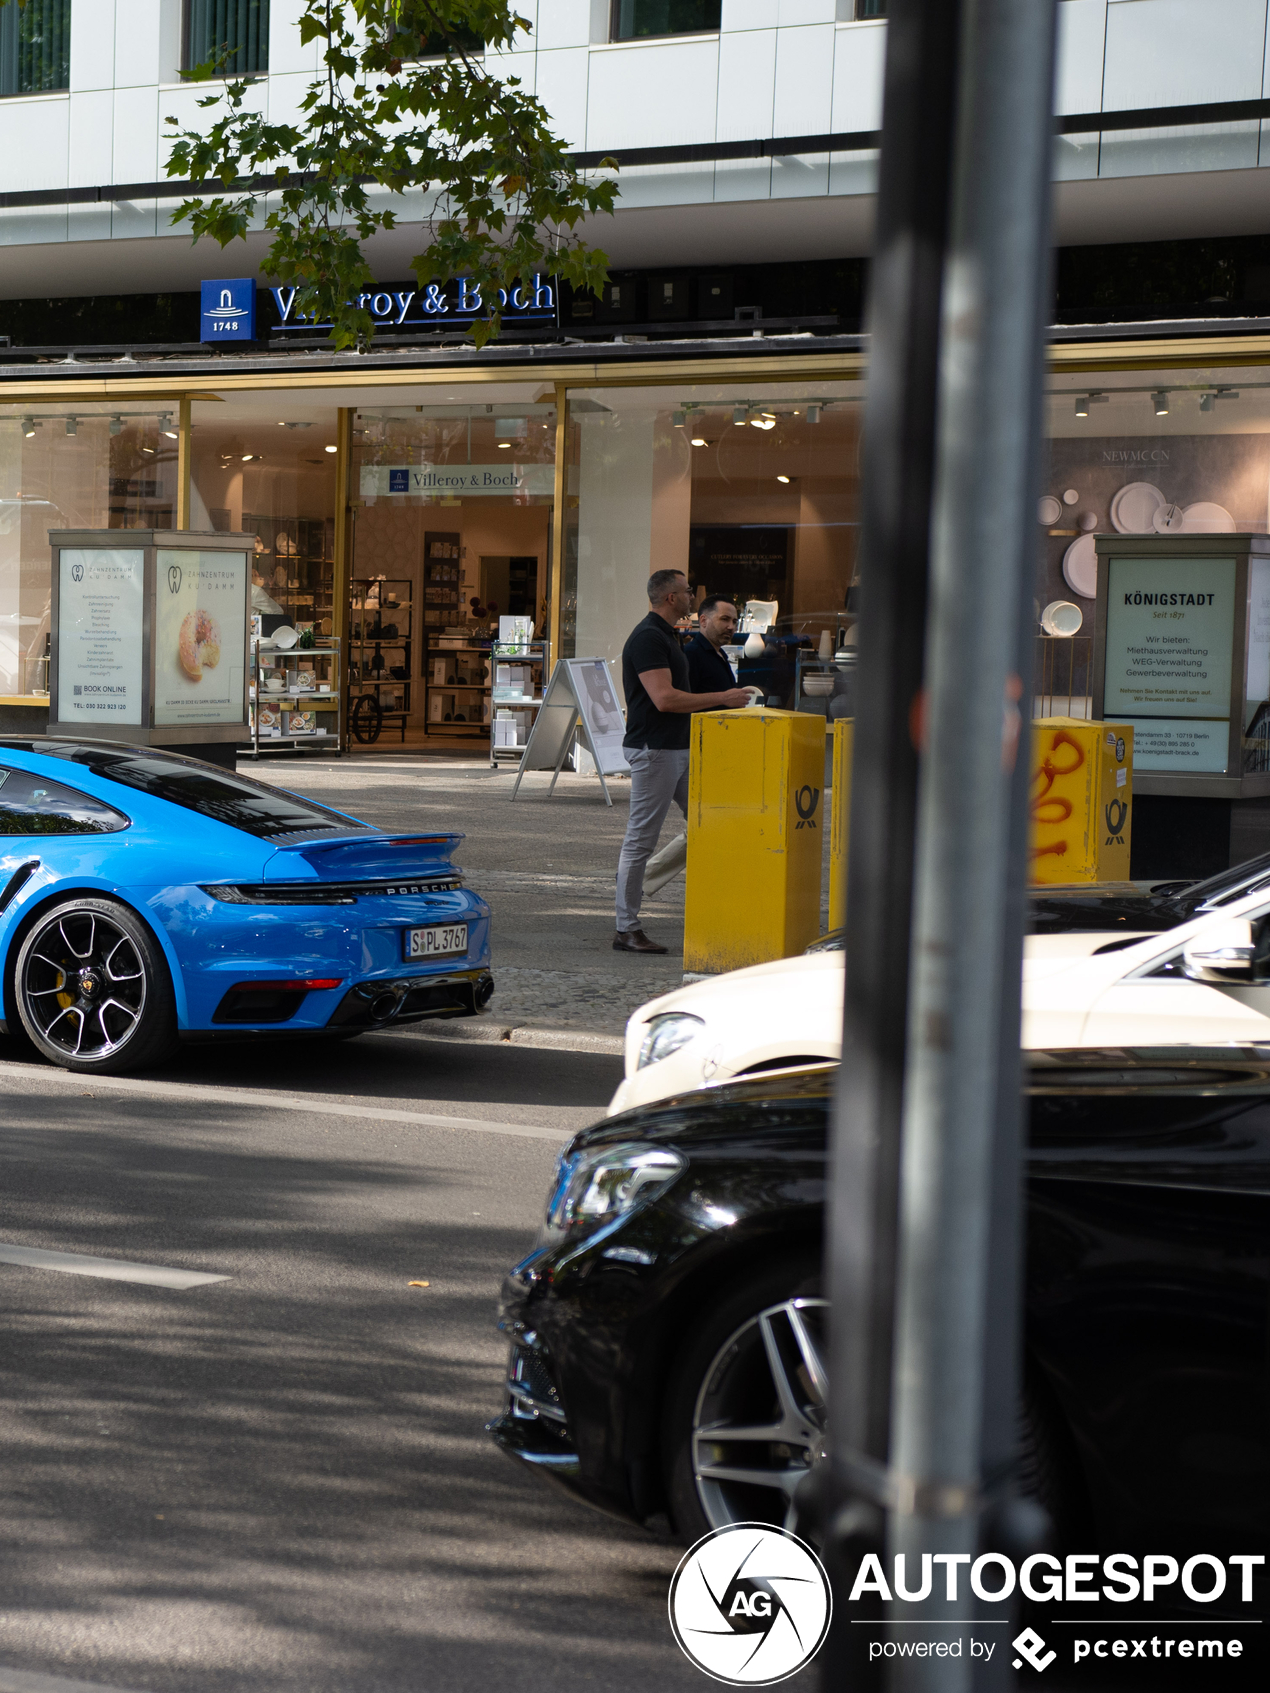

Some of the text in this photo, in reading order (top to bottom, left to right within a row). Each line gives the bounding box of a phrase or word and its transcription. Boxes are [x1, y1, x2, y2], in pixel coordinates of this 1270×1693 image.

[270, 286, 416, 325] Vroy
[423, 284, 449, 314] &
[213, 322, 238, 332] 1748
[413, 472, 519, 489] Villeroy & Boch
[188, 570, 235, 578] ZAHNZENTRUM
[1124, 590, 1215, 606] KÖNIGSTADT
[1170, 611, 1185, 620] 1871
[1127, 647, 1208, 656] Miethausverwaltung
[1132, 658, 1202, 667] WEG-Verwaltung
[1126, 669, 1207, 679] Gewerbeverwaltung
[386, 883, 456, 896] PORSCHE
[412, 927, 466, 953] S PL 3767
